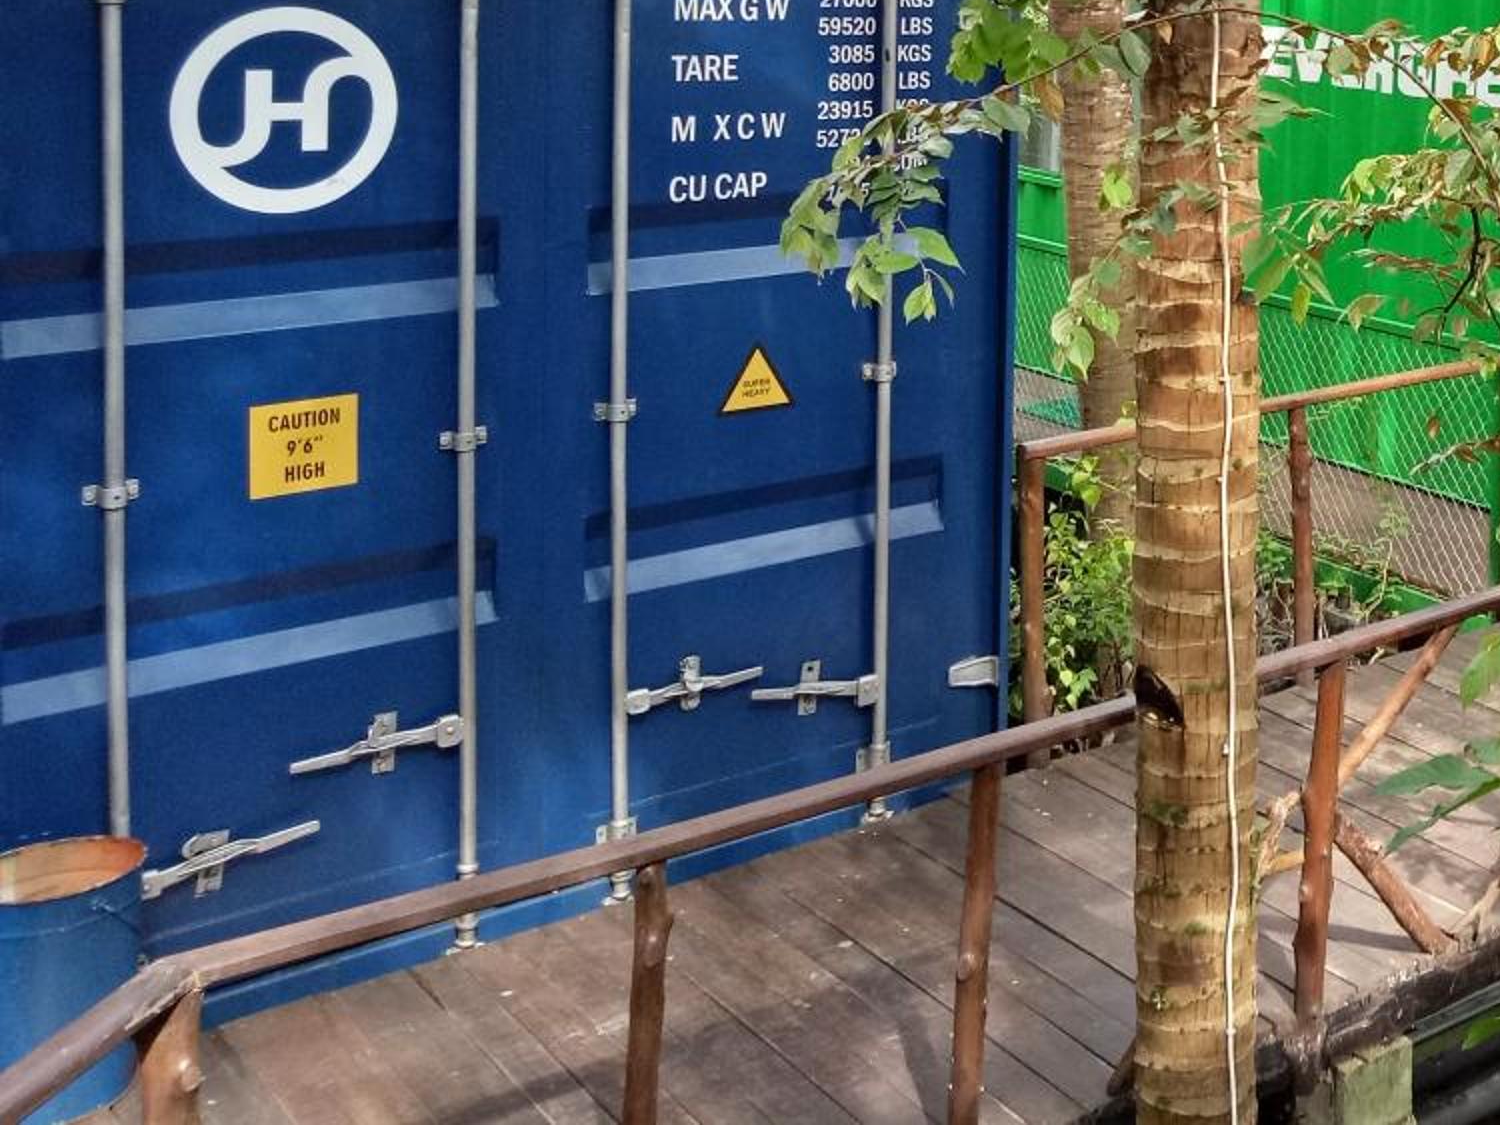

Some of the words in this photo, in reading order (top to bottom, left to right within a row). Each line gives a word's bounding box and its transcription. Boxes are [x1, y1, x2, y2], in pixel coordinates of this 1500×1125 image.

[818, 17, 877, 35] 59520
[901, 17, 933, 35] LBS
[829, 44, 875, 63] 3085
[897, 45, 932, 62] KGS
[671, 54, 739, 81] TARE
[828, 73, 874, 91] 6800
[899, 72, 931, 90] LBS
[817, 100, 873, 119] 23915
[816, 128, 872, 147] 527
[668, 176, 707, 202] CU
[715, 172, 768, 198] CAP
[268, 408, 340, 433] CAUTION
[285, 461, 325, 483] HIGH
